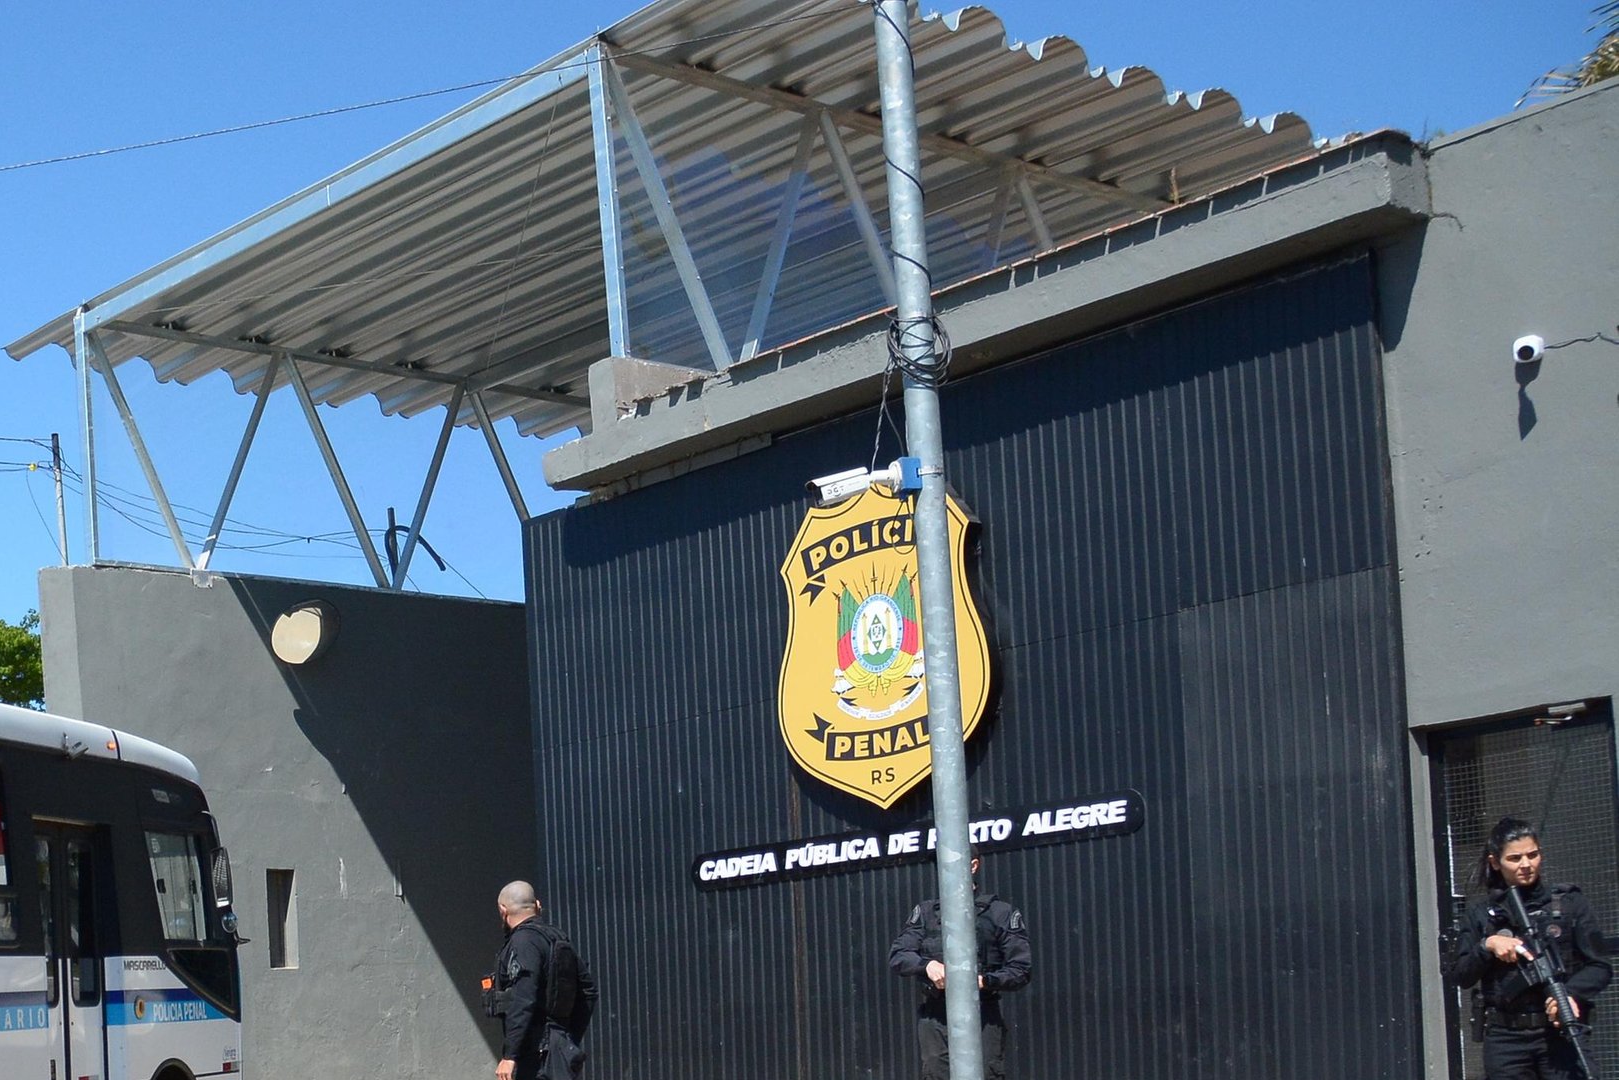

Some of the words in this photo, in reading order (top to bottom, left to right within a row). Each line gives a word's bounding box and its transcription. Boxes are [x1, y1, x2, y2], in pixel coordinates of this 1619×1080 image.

[808, 518, 913, 572] POLÍCI
[833, 721, 930, 758] PENAL
[871, 767, 896, 785] RS
[698, 852, 778, 882] CADEIA
[784, 837, 881, 870] PÚBLICA
[887, 830, 921, 856] DE
[1021, 799, 1128, 837] ALEGRE
[183, 1000, 208, 1020] PENAL
